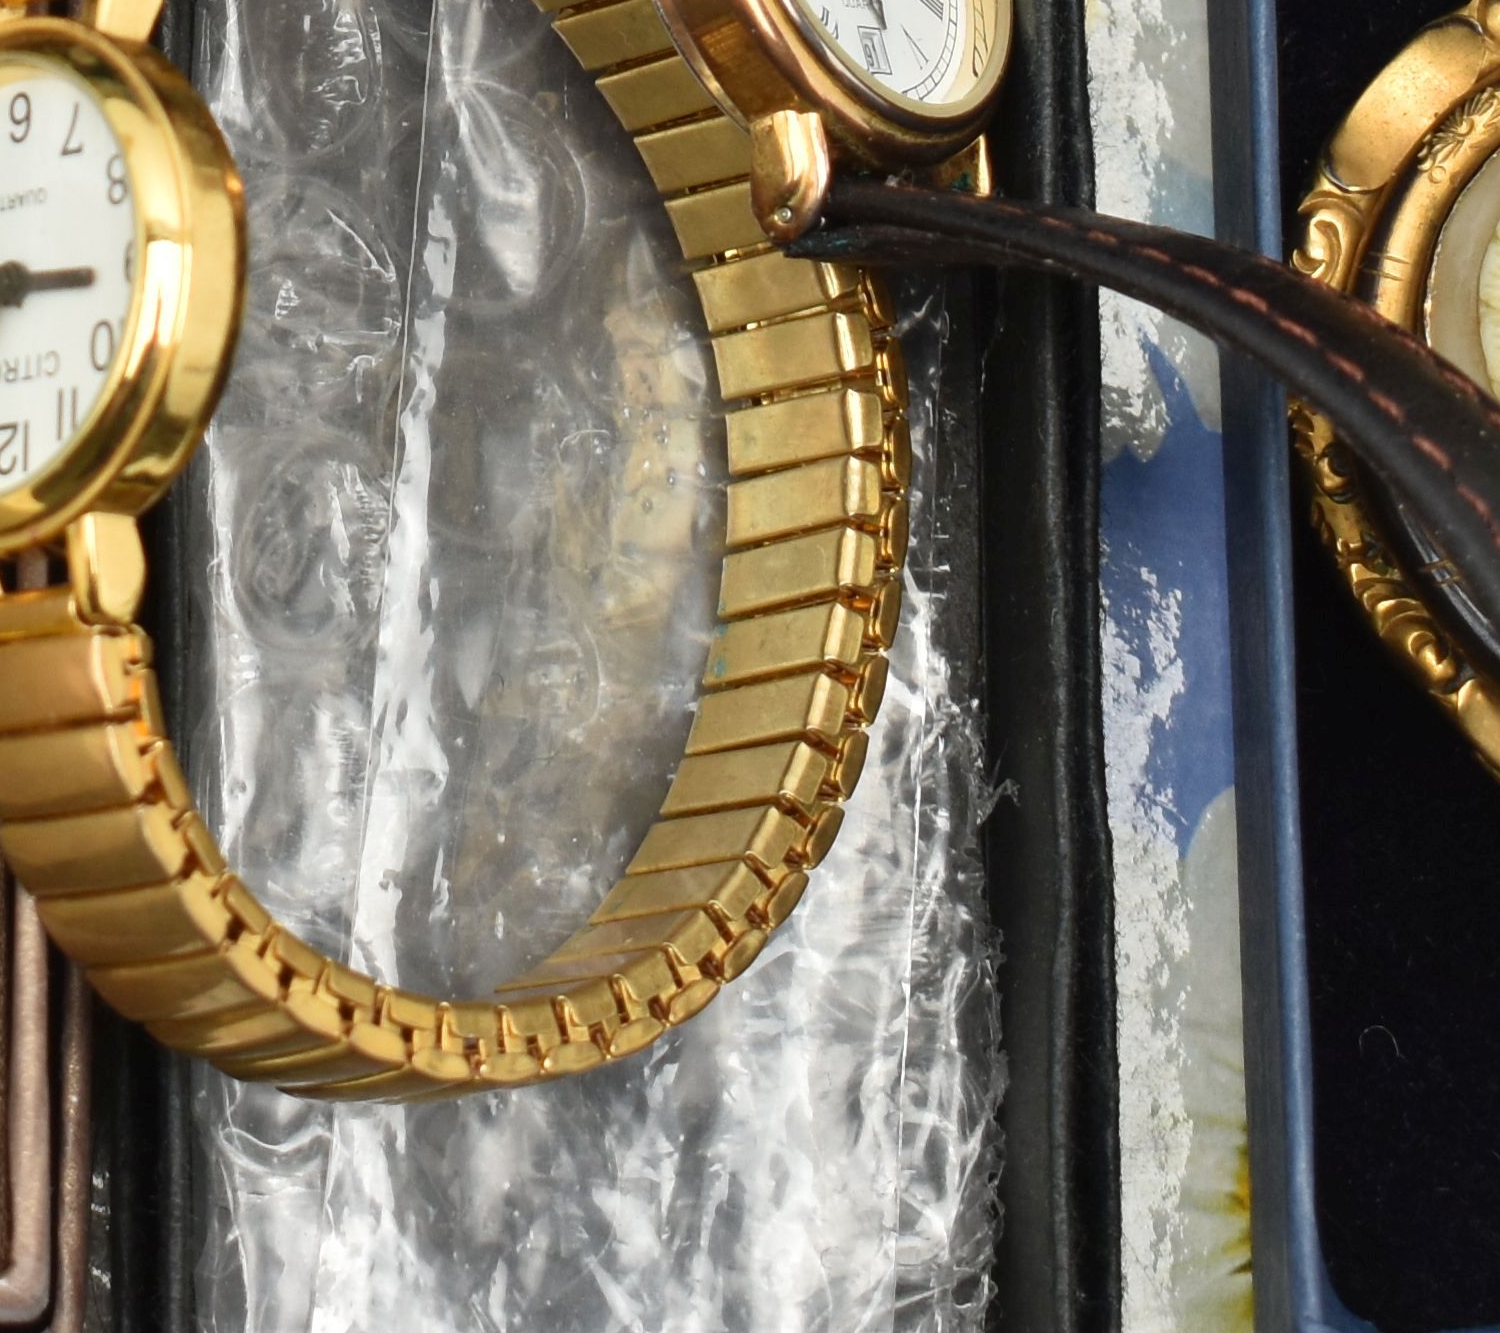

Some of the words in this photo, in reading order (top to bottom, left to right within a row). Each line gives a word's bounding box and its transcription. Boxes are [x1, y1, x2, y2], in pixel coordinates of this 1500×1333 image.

[9, 91, 32, 144] 6
[60, 102, 85, 157] 7
[106, 154, 128, 205] 8
